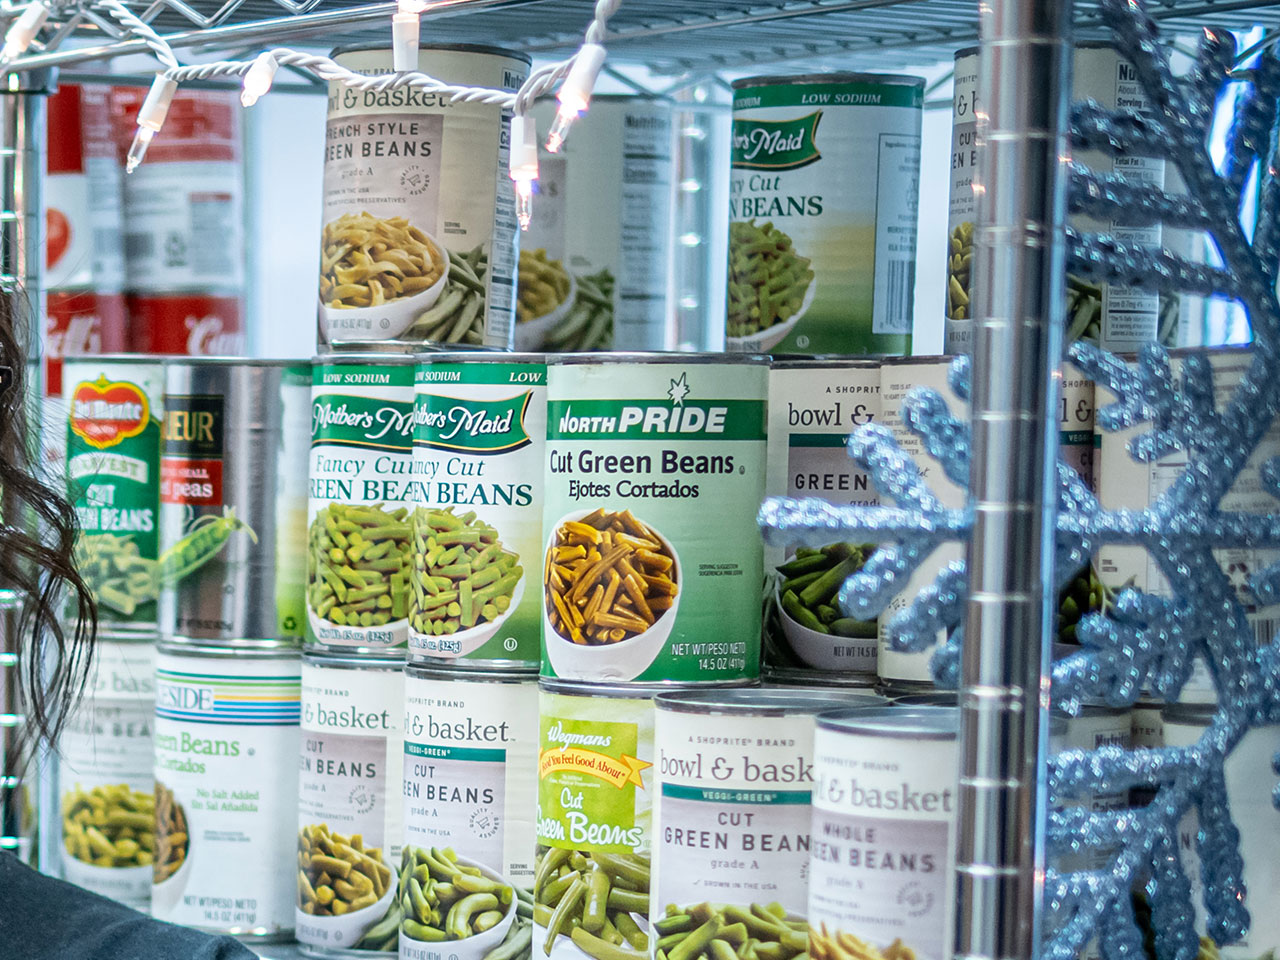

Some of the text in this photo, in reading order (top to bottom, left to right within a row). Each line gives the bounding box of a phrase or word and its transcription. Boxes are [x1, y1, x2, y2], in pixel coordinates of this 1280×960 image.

[801, 93, 881, 105] LOW SODIUM
[367, 123, 419, 136] STYLE
[361, 141, 431, 158] BEANS
[744, 128, 805, 160] Maid
[749, 174, 781, 192] Cut
[742, 196, 823, 218] BEANS
[344, 373, 390, 384] SODIUM
[425, 371, 542, 383] SODIUM LOW
[311, 402, 373, 436] Mother's
[439, 406, 514, 439] Maid
[559, 405, 729, 433] NORTH PRIDE
[788, 402, 875, 426] bowl &
[316, 455, 365, 477] Fancy
[446, 457, 486, 476] Cut
[550, 449, 735, 475] Cut Green Beans
[568, 480, 699, 501] Ejotes Cortados
[795, 474, 868, 490] GREEN
[437, 482, 533, 506] BEANS
[671, 642, 729, 656] NET WT/PESO
[856, 647, 871, 658] 14.5
[698, 658, 727, 671] 14.5 OZ
[324, 689, 350, 698] BRAND
[436, 700, 465, 709] BRAND
[317, 703, 390, 730] basket
[412, 714, 510, 742] & basket
[547, 721, 612, 752] Wegmans
[181, 731, 239, 756] Beans
[306, 739, 324, 754] CUT
[756, 739, 795, 747] BRAND
[316, 759, 376, 779] BEANS
[414, 763, 436, 779] CUT
[561, 754, 622, 780] Feel Good About
[661, 748, 702, 779] bowl
[711, 757, 734, 781] &
[742, 756, 814, 782] bask
[196, 789, 260, 800] No Salt Added
[426, 784, 494, 804] BEANS
[560, 787, 584, 810] Cut
[851, 779, 953, 813] basket
[206, 801, 219, 811] Sal
[431, 808, 439, 817] A
[565, 811, 643, 847] Beans
[717, 812, 755, 827] CUT
[664, 826, 810, 852] GREEN BEAN
[823, 823, 875, 844] WHOLE
[710, 860, 759, 870] grade A
[849, 849, 936, 874] BEANS
